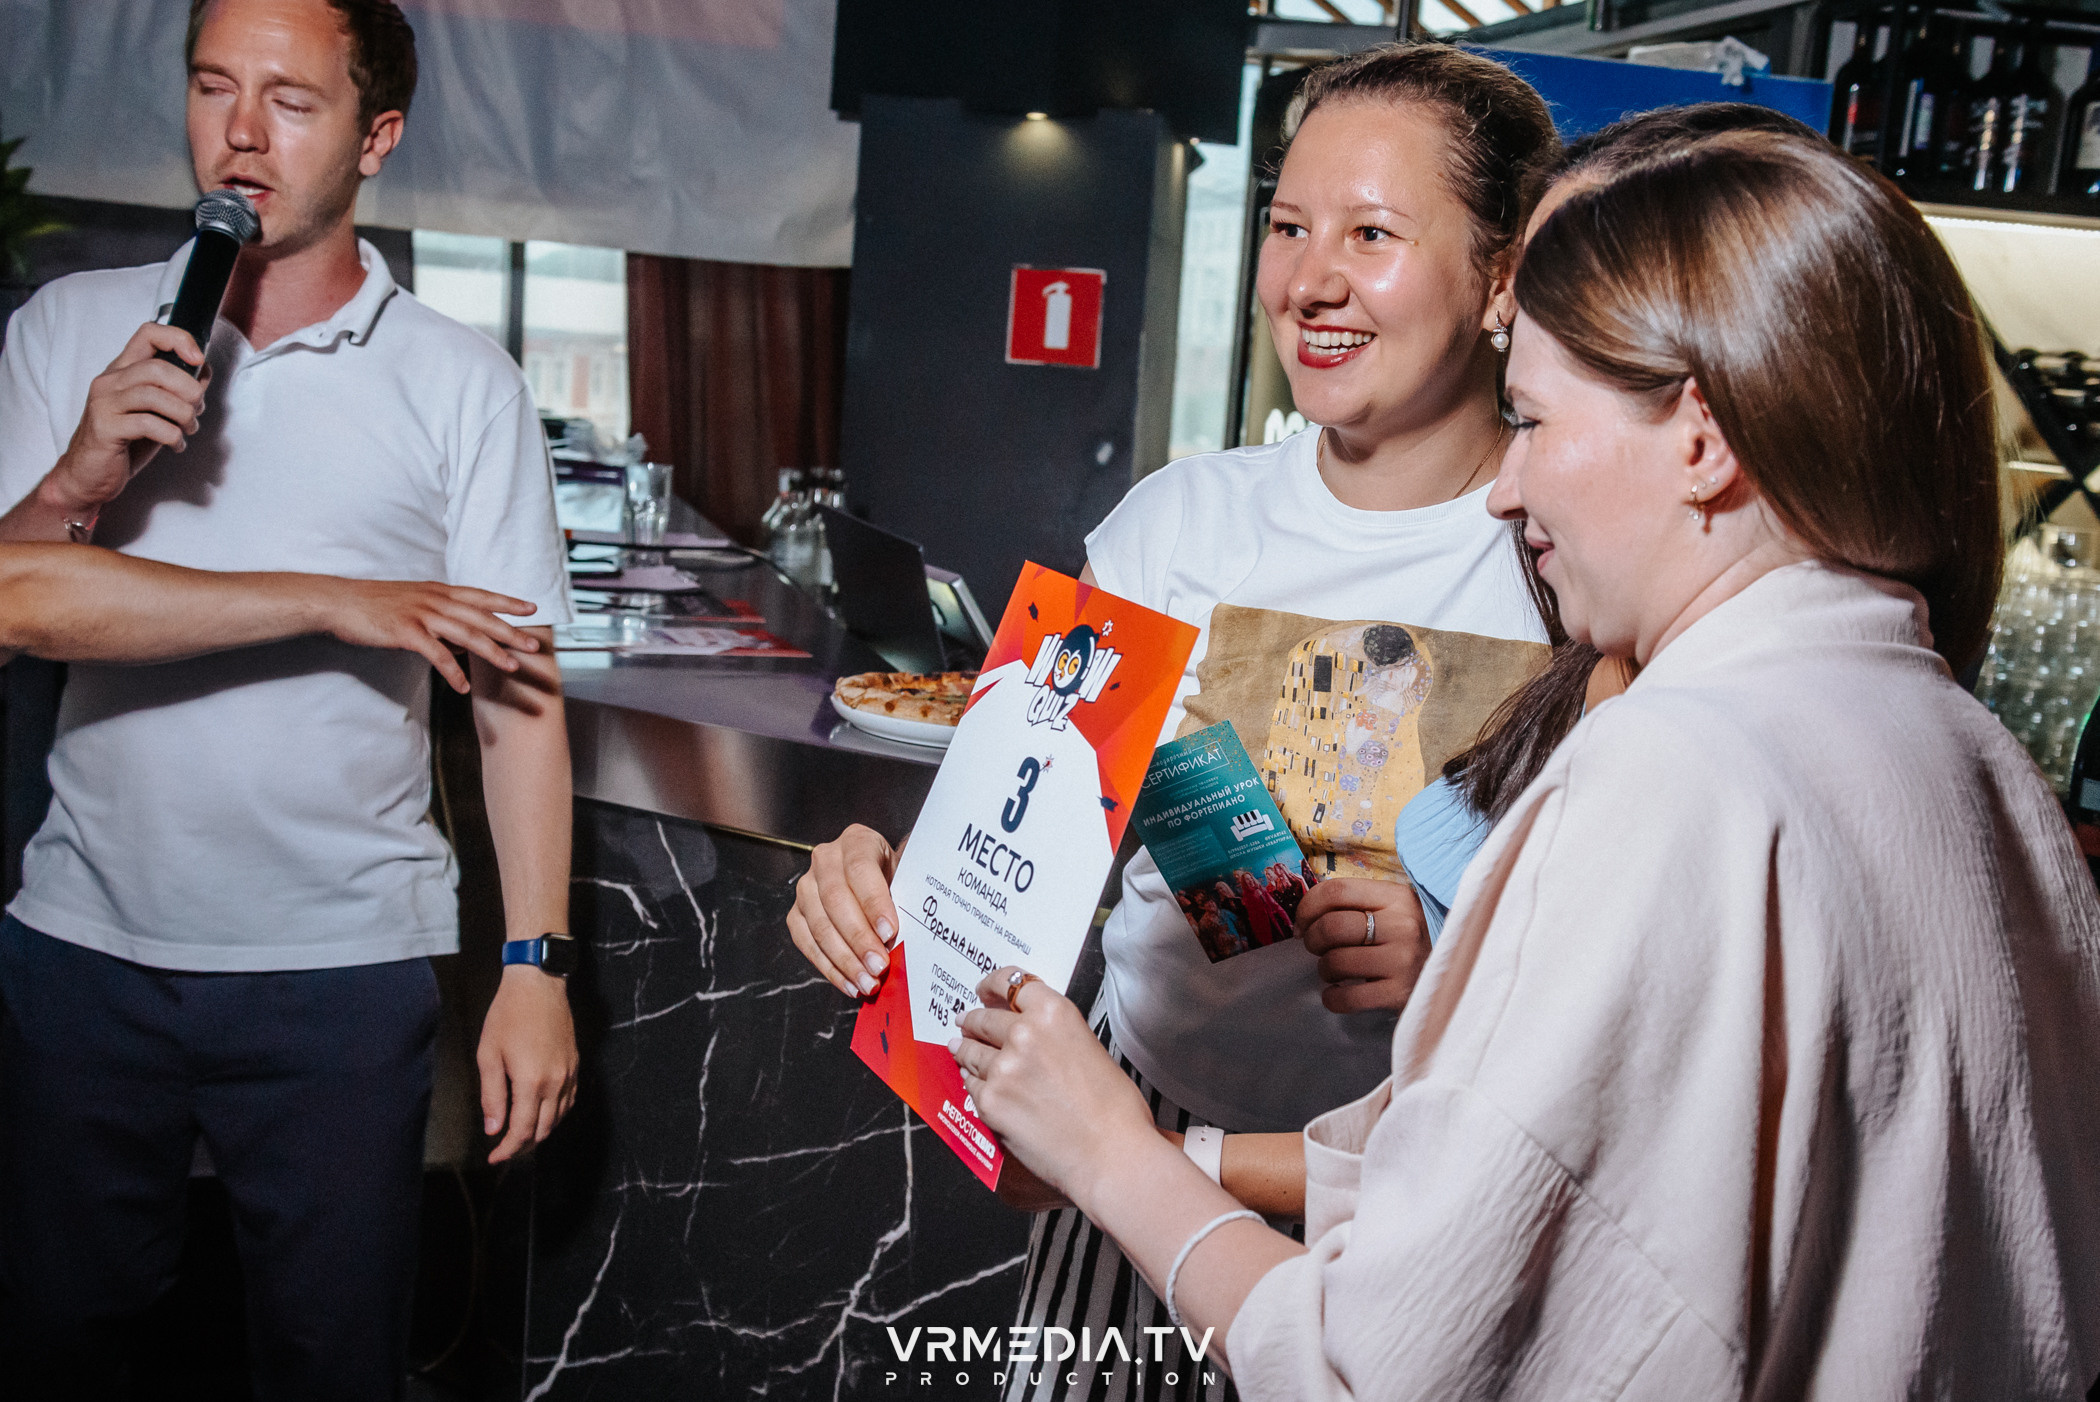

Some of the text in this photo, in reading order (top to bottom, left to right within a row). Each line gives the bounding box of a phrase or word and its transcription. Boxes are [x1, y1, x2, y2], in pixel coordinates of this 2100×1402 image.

[1026, 684, 1081, 732] QUIZ
[1141, 748, 1222, 789] СЕРТИФИКАТ
[1001, 756, 1041, 833] 3
[1142, 785, 1232, 827] ИНДИВИДУАЛЬНЫЙ
[1233, 777, 1260, 793] УРОК
[1167, 794, 1246, 829] ПО ФОРТЕПИАНО
[957, 823, 1034, 893] МЕСТО
[925, 874, 1032, 956] КОТОРАЯ ТОЧНО ПРИДЕТ НА РЕВАНШ
[957, 867, 1008, 916] КОМАНДА,
[930, 982, 954, 1005] ИГР №
[931, 963, 978, 1006] ПОБЕДИТЕЛИ
